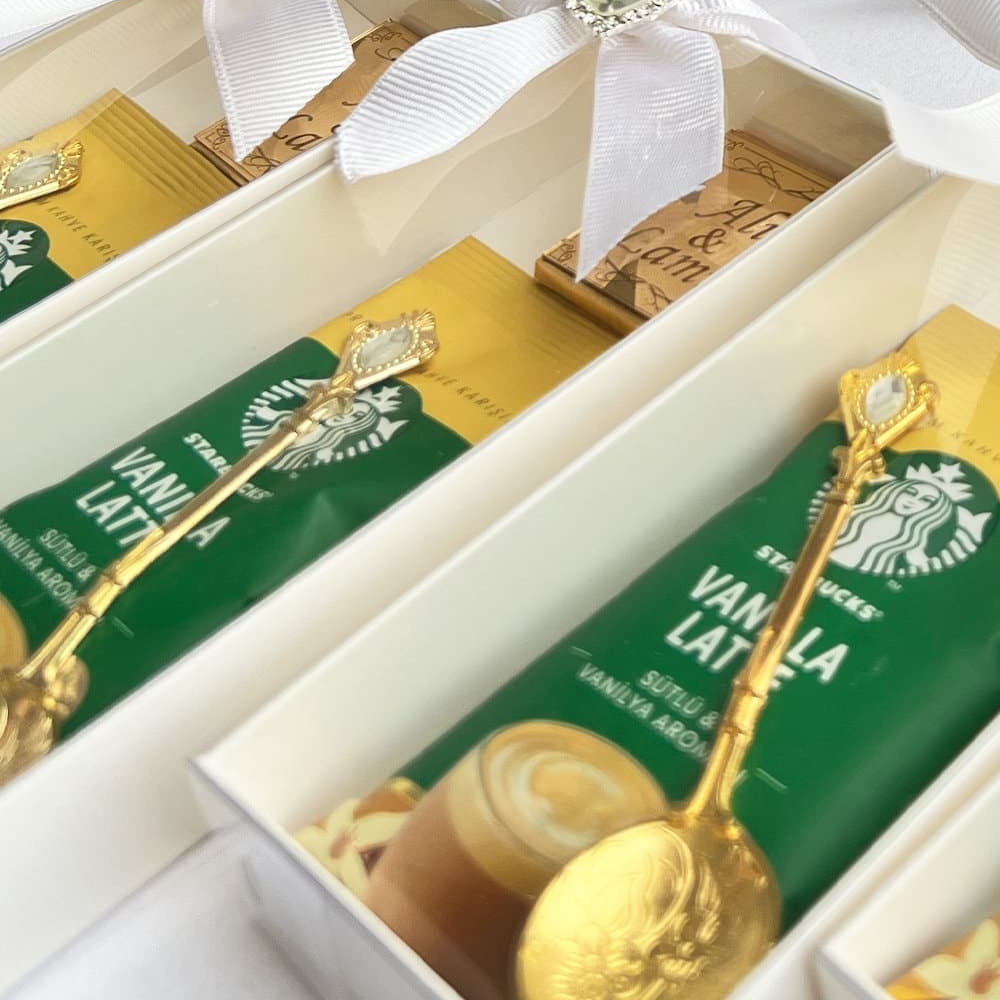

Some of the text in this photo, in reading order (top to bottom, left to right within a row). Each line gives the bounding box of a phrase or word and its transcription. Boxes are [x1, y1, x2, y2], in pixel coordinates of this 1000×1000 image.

[616, 226, 711, 283] Lam
[687, 227, 727, 255] &
[75, 479, 164, 547] LATT
[111, 446, 232, 549] VANIA
[755, 545, 876, 622] STAUCKS
[665, 610, 797, 690] LAT
[689, 564, 849, 684] VANLA
